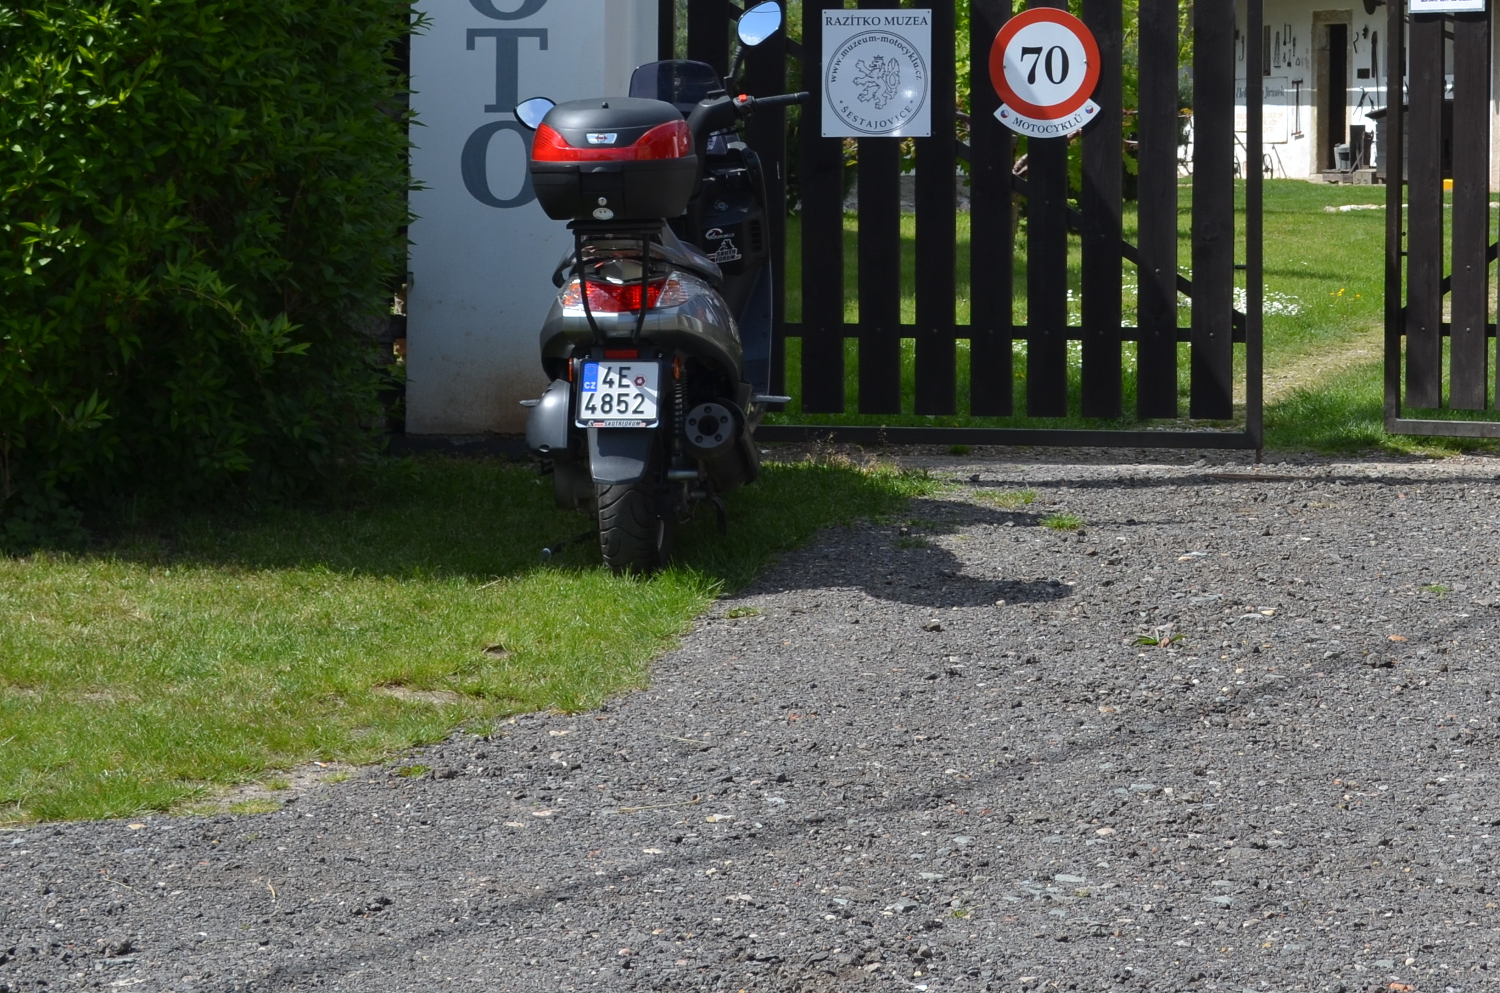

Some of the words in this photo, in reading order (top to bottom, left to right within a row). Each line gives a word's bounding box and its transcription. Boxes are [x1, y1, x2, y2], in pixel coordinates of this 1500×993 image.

[825, 14, 881, 26] RAZÍTKO
[884, 16, 928, 26] MUZEA
[831, 35, 922, 83] www.muzeum-motocyklu.cz
[1020, 45, 1070, 85] 70
[841, 105, 912, 129] ŠESTAJOVICE
[1012, 113, 1083, 134] MOTOCYKLŮ
[584, 381, 597, 389] CZ
[602, 366, 631, 388] 4E
[584, 393, 646, 415] 4852
